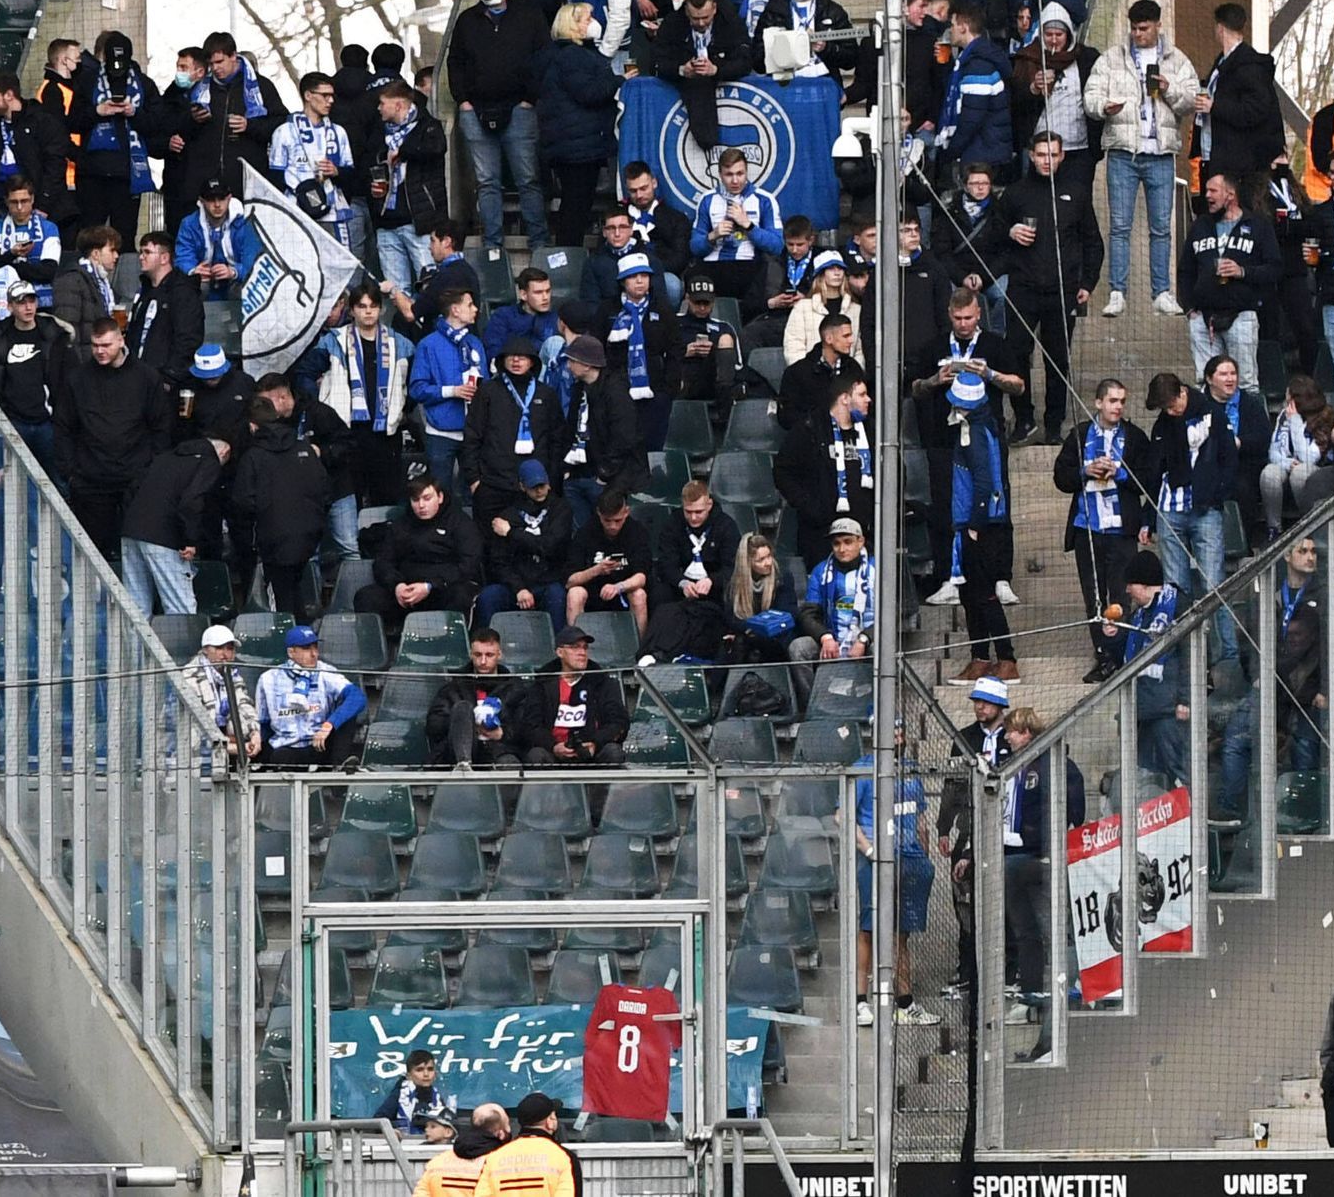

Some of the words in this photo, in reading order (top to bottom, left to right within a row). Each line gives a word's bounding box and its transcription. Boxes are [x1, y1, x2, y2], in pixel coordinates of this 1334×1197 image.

[1192, 235, 1255, 255] BERLIN
[1075, 890, 1100, 937] 18
[369, 1014, 465, 1047] Wir
[482, 1013, 575, 1050] für
[618, 1024, 641, 1073] 8
[973, 1175, 1126, 1197] SPORTWETTEN
